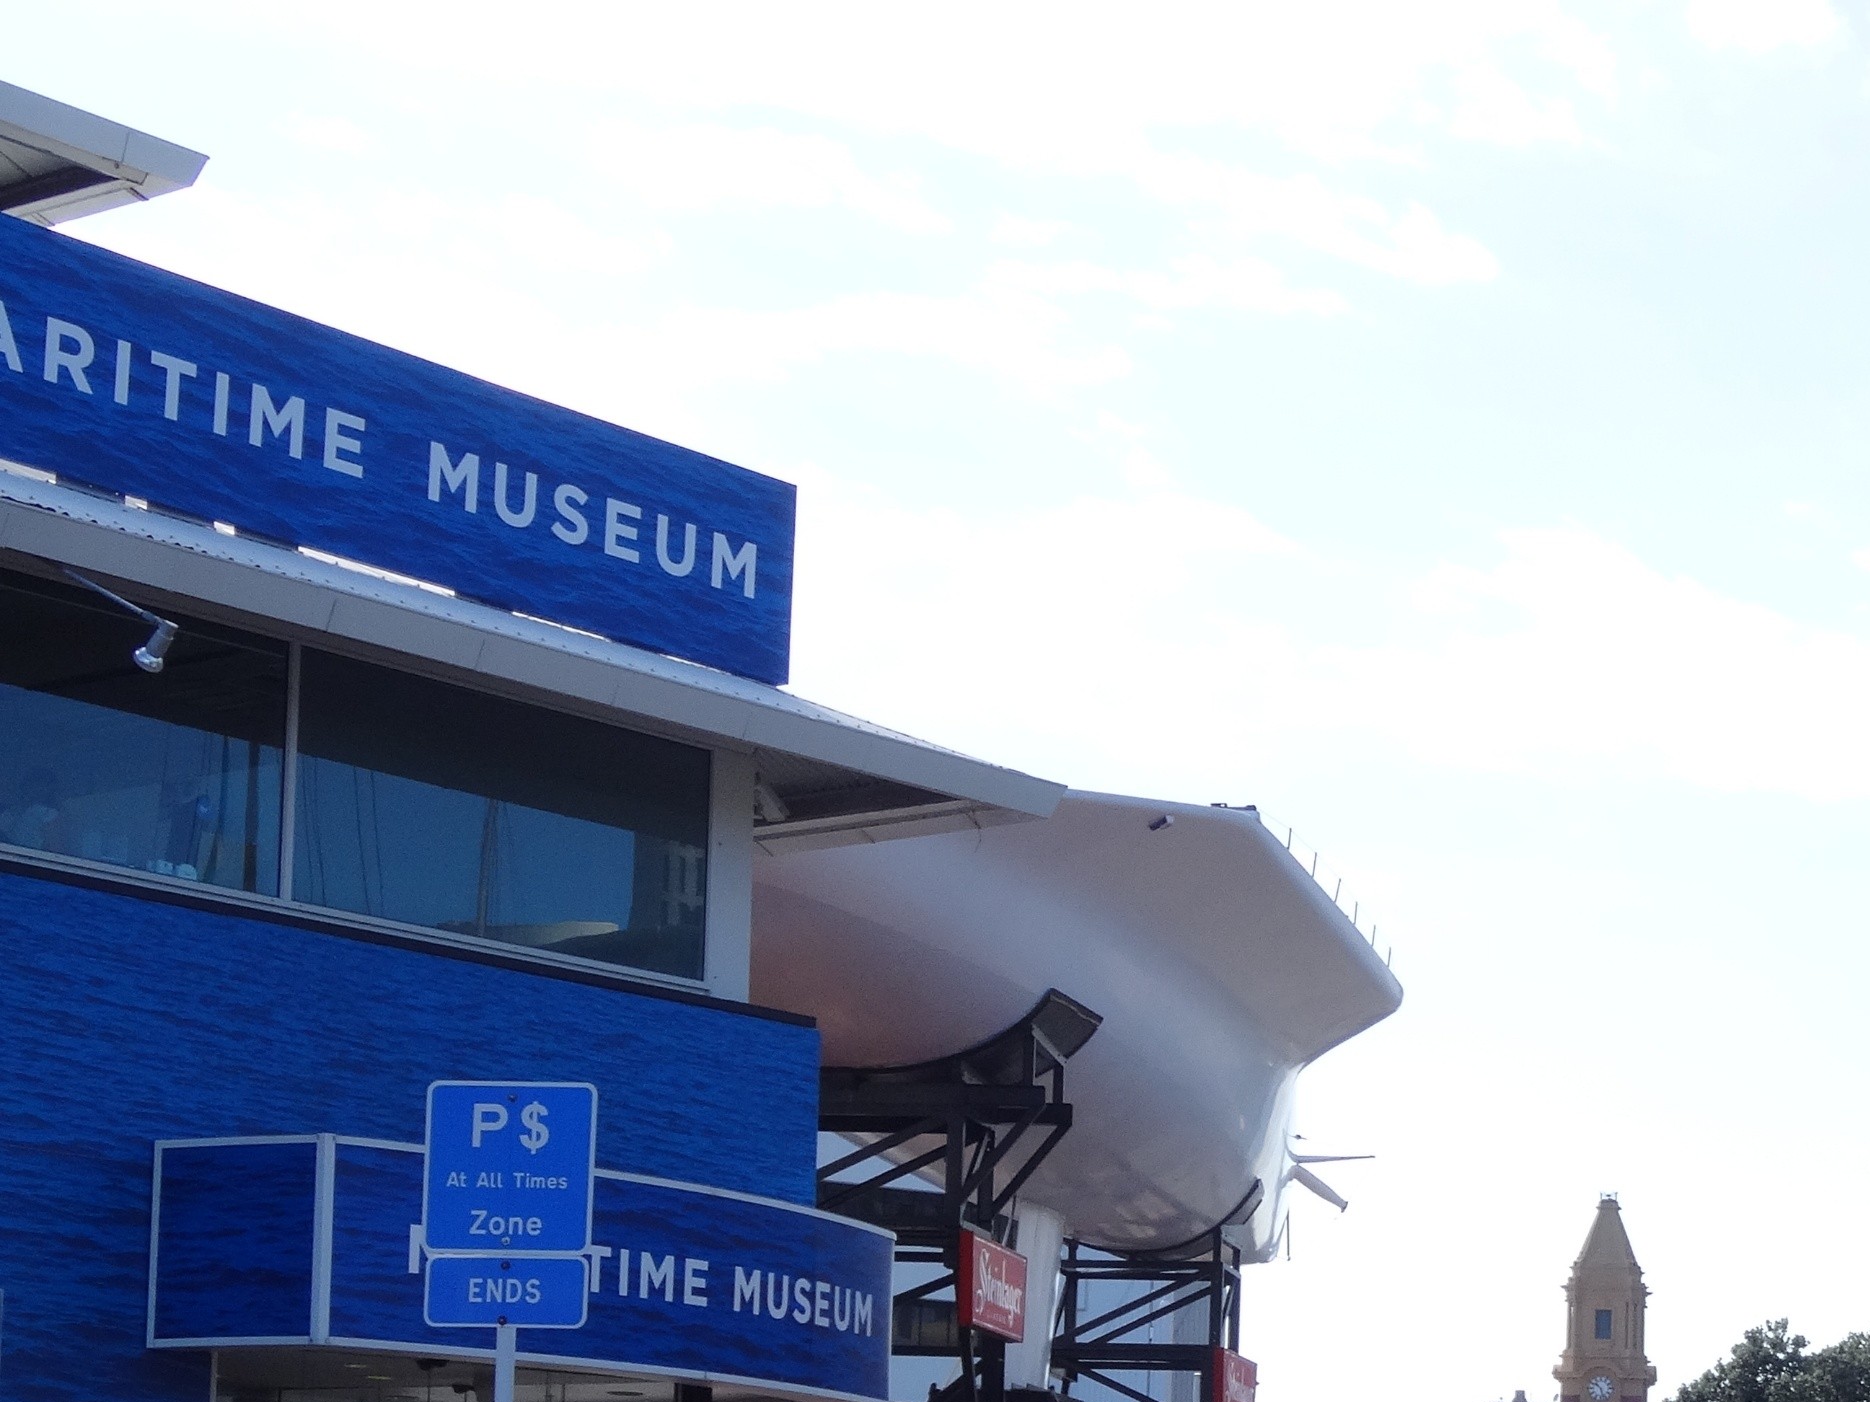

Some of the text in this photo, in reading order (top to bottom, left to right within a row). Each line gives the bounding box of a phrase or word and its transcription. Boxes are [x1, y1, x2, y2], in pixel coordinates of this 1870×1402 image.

[427, 441, 758, 599] MUSEUM
[446, 1171, 568, 1190] At All Times
[469, 1210, 543, 1235] Zone
[468, 1278, 542, 1304] ENDS
[733, 1265, 873, 1337] MUSEUM
